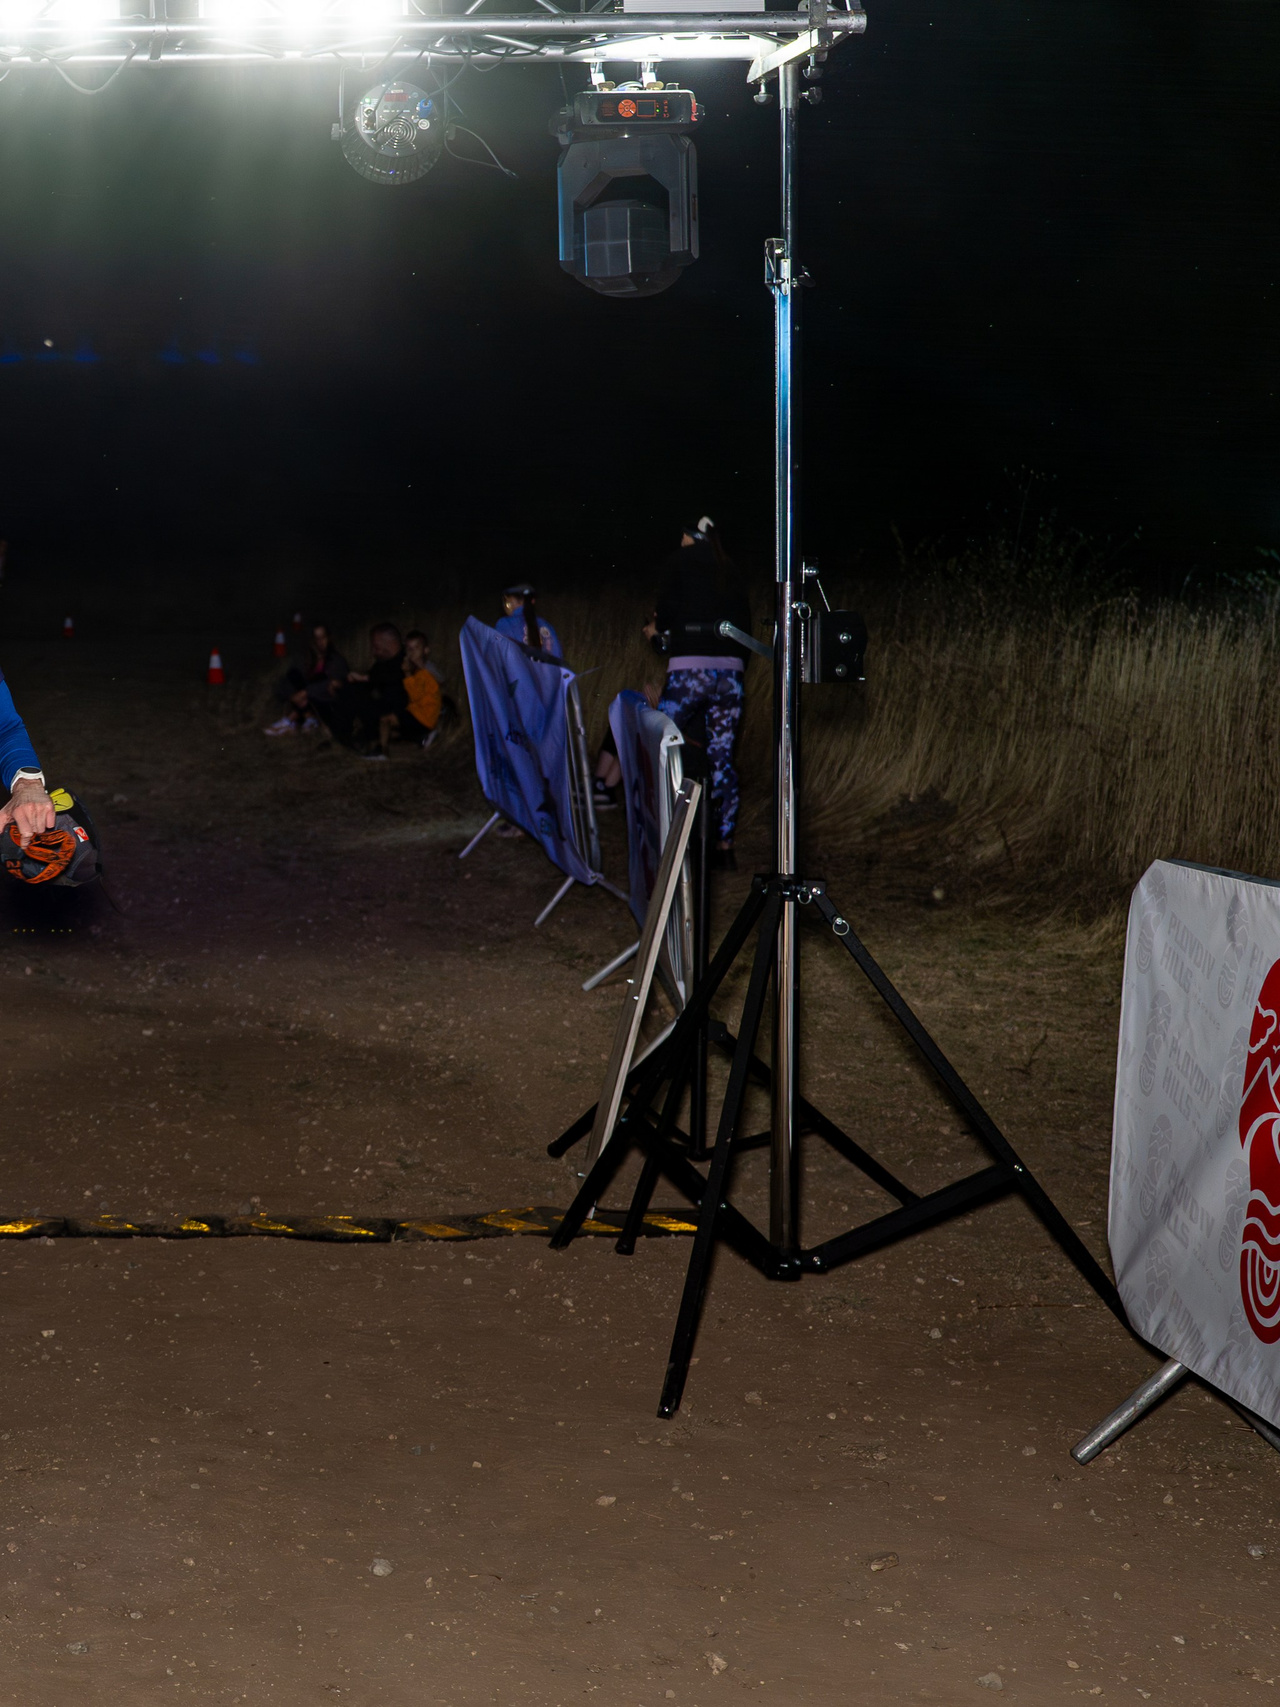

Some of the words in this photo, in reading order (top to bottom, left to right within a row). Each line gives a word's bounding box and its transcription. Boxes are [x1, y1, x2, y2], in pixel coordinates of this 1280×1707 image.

[1160, 941, 1193, 994] HILLS
[1167, 910, 1216, 980] PLOVDIV
[1162, 1066, 1193, 1121] HILLS
[1168, 1035, 1215, 1110] PLOVDIV
